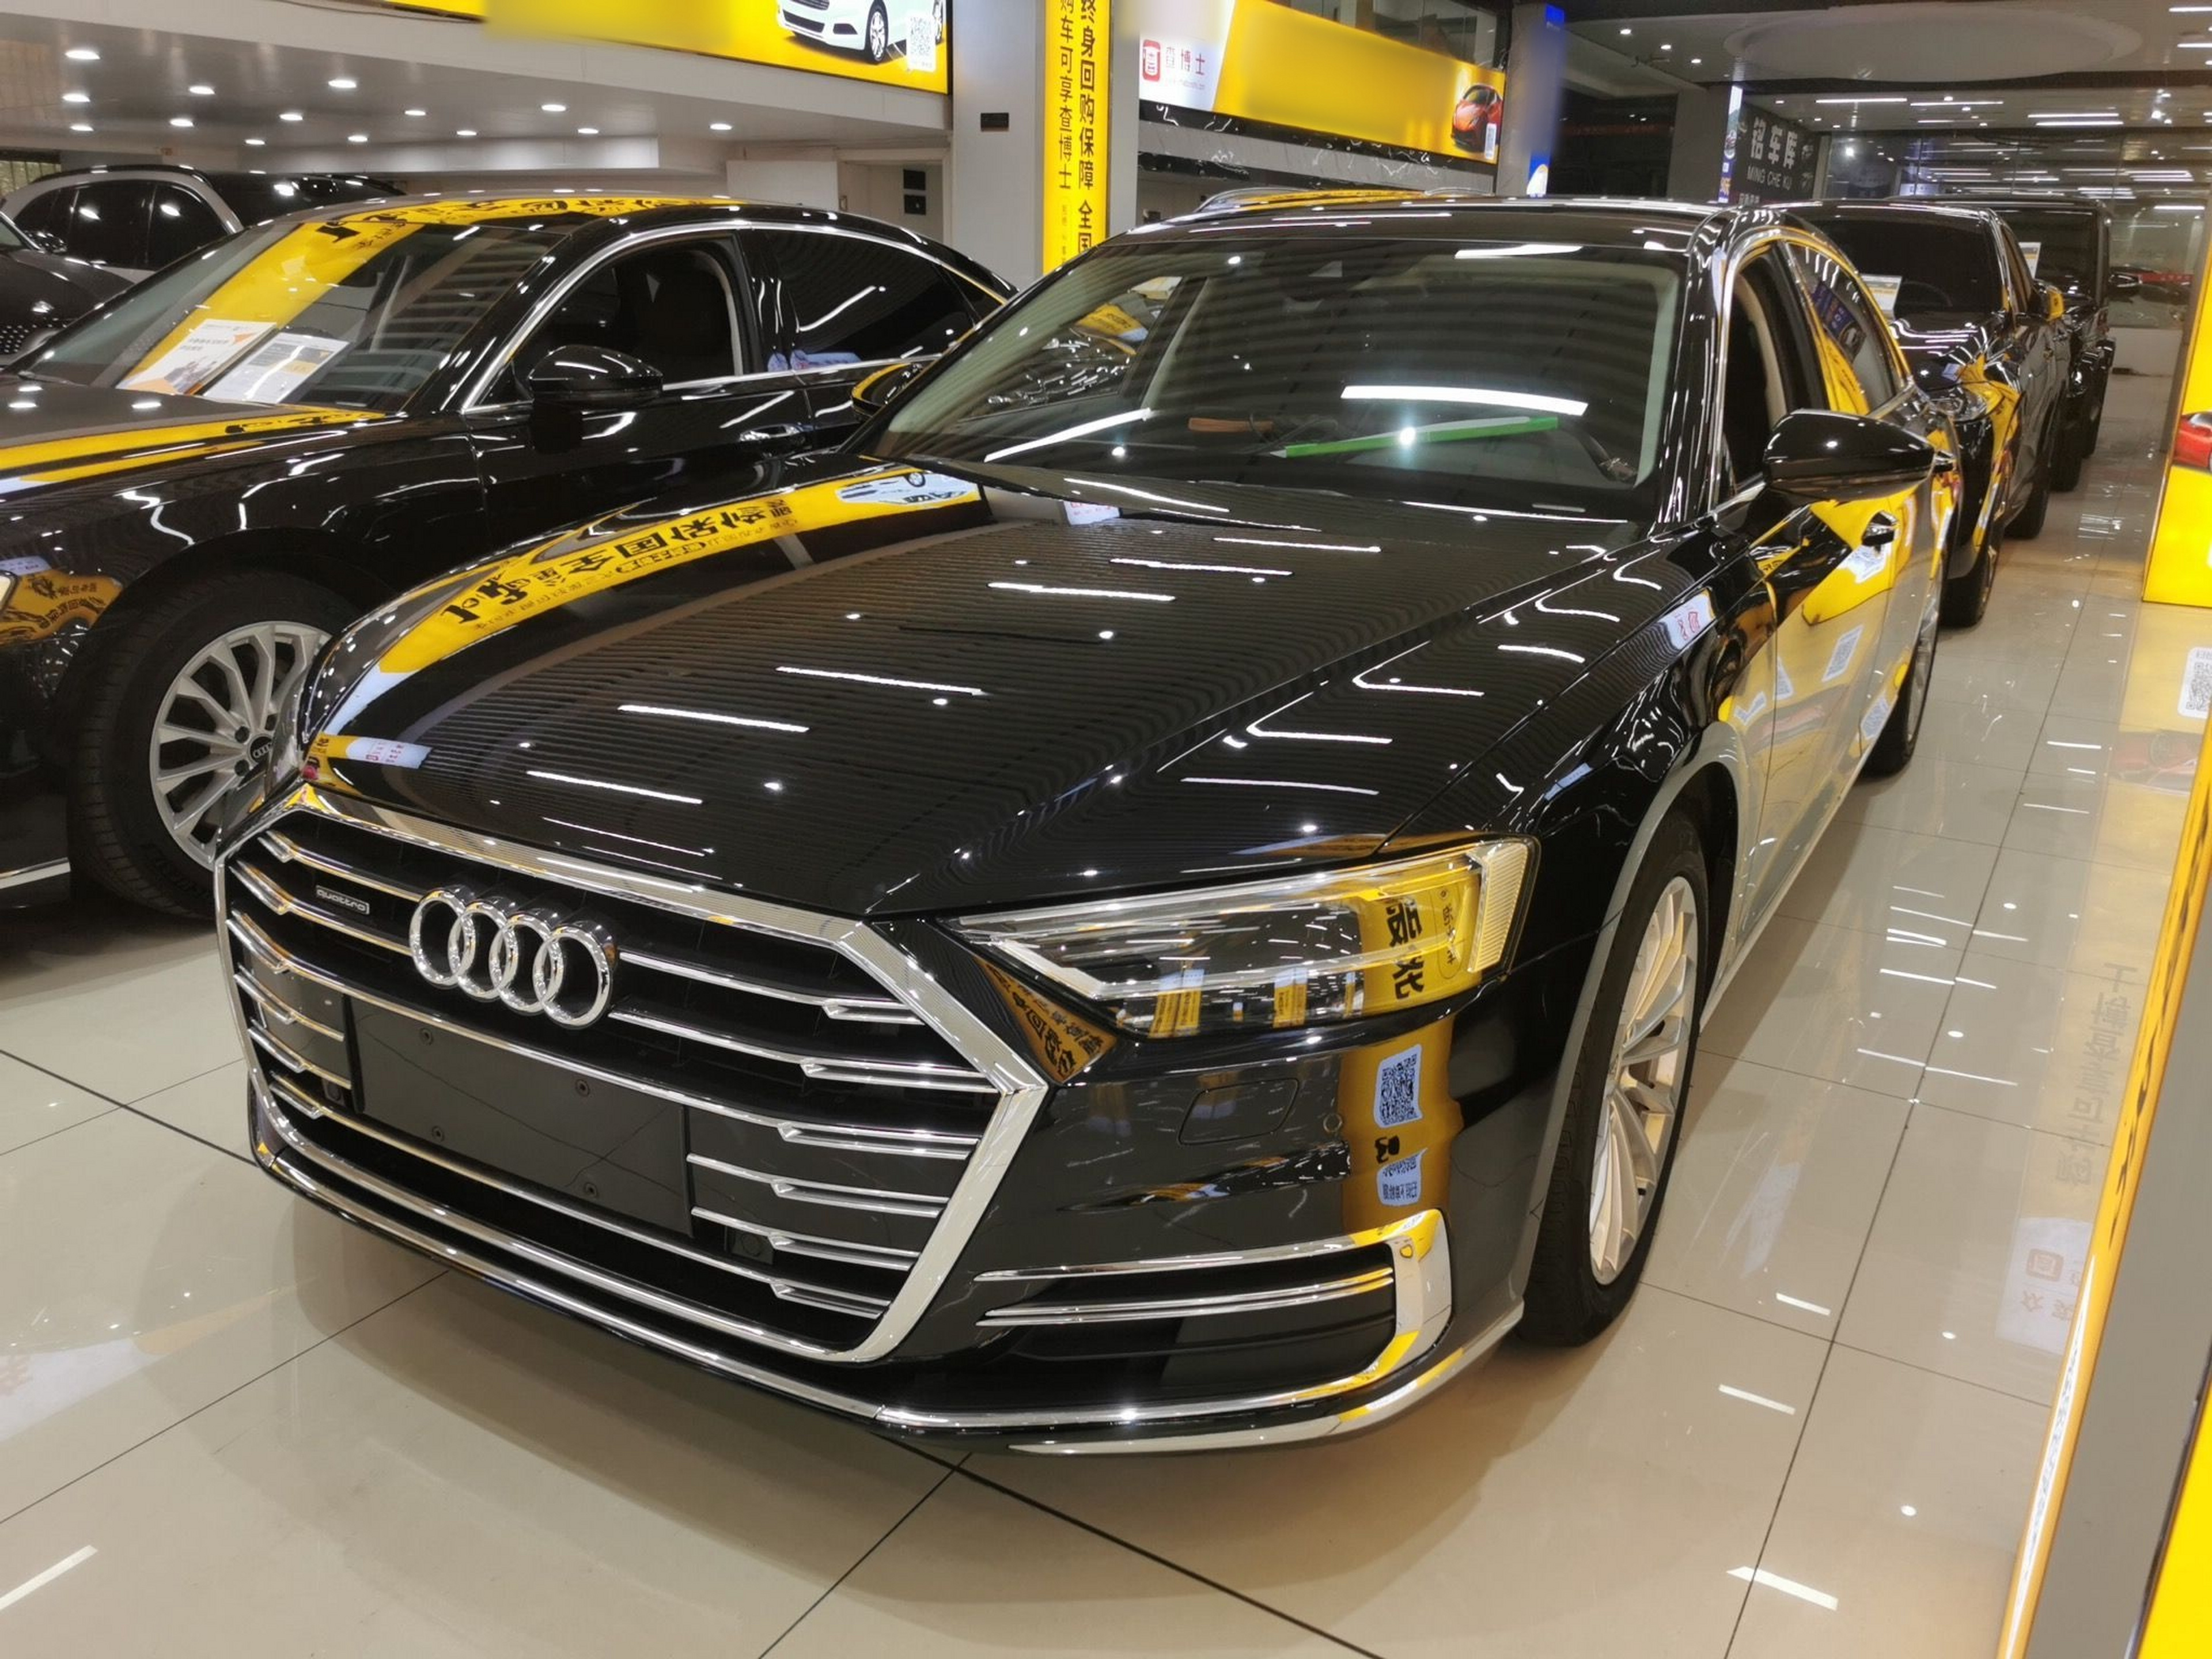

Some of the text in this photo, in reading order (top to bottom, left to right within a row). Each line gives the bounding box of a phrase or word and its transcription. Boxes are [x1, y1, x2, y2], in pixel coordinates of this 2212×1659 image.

[1079, 0, 1096, 191] 终身回购保障
[317, 889, 366, 911] quattro
